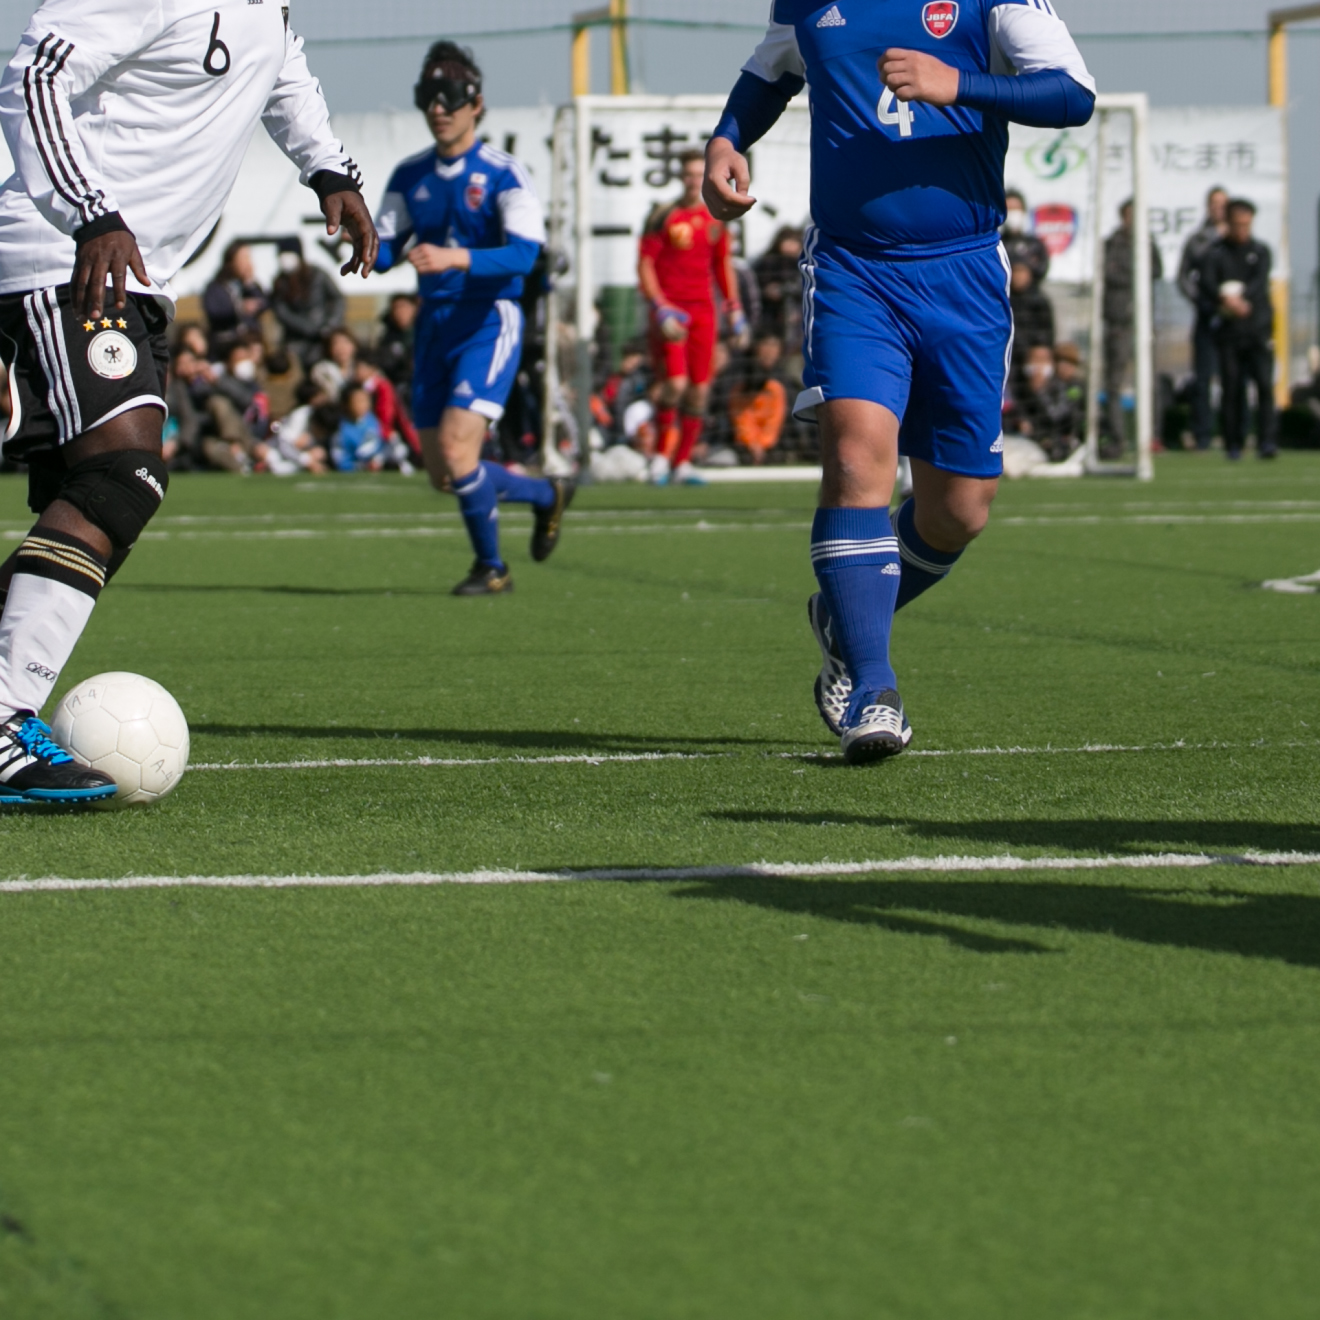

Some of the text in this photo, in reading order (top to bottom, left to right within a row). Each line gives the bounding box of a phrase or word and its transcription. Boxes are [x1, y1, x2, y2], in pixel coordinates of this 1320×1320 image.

[816, 18, 847, 28] adidas
[925, 12, 954, 22] JBFA
[202, 11, 231, 77] 6
[877, 84, 915, 137] 4
[71, 688, 98, 708] A-4
